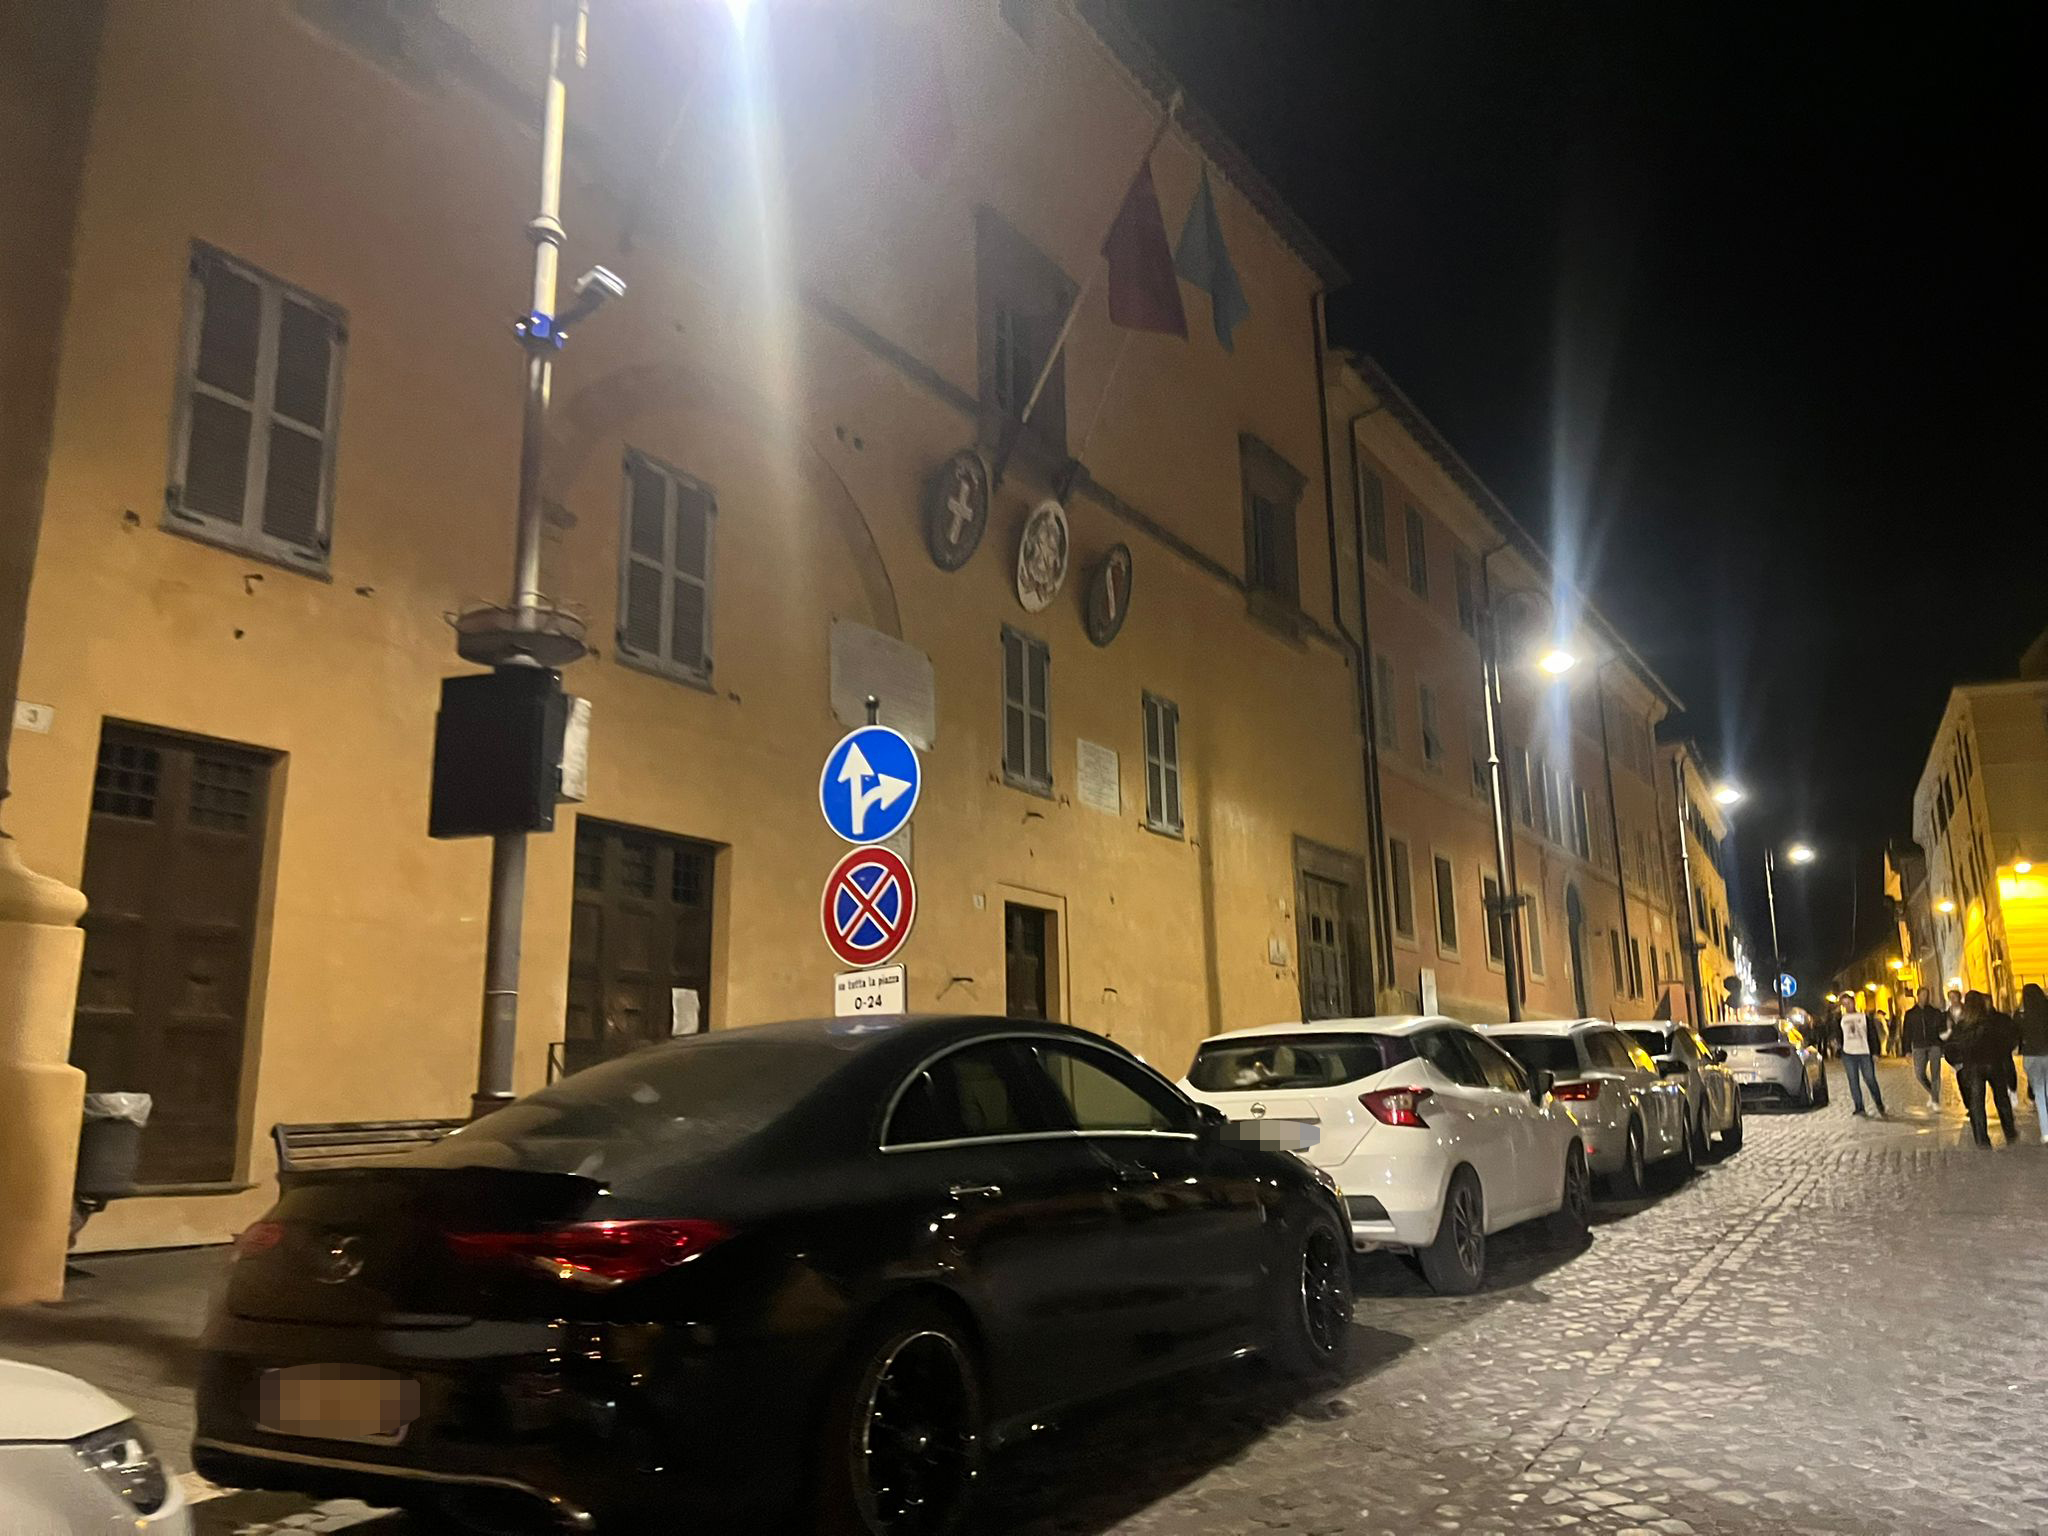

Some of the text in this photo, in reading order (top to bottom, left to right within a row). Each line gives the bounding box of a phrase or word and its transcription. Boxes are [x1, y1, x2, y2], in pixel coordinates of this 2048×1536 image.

[848, 979, 866, 990] tutta
[868, 976, 876, 987] la
[878, 975, 899, 986] piazza
[854, 994, 882, 1010] 0-24
